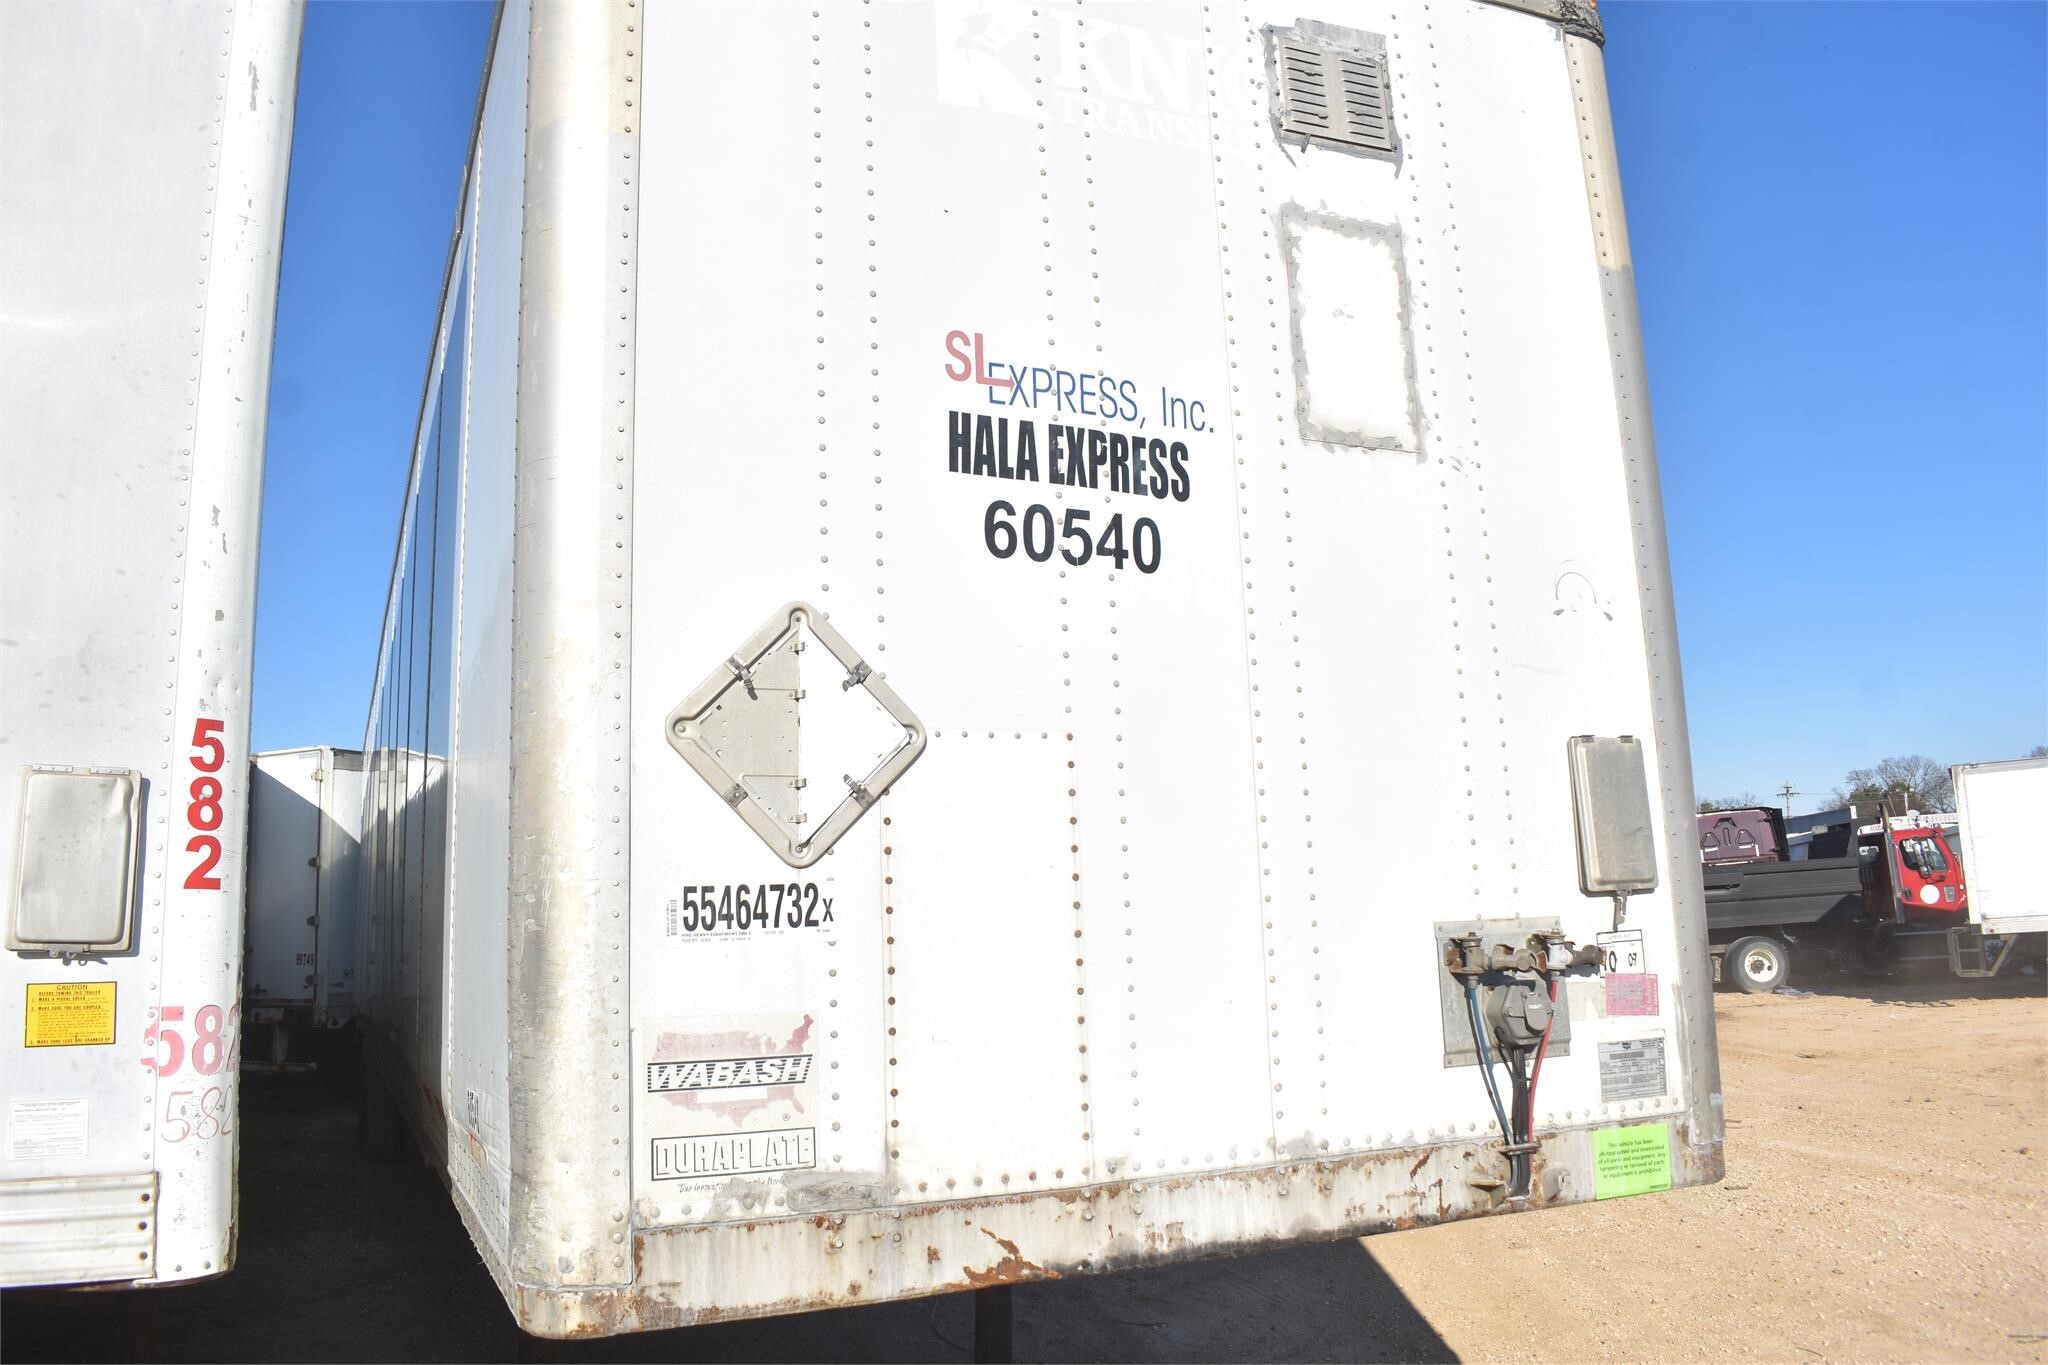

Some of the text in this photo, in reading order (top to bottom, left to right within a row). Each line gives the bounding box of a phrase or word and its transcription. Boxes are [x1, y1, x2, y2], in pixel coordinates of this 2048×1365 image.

[1161, 386, 1215, 433] Inc.
[948, 410, 1191, 503] HALA EXPRESS
[984, 499, 1162, 574] 60540
[183, 718, 225, 890] 582
[649, 1056, 811, 1091] WABASH
[655, 1134, 810, 1175] DURAPLATE
[1599, 1149, 1629, 1157] photographed
